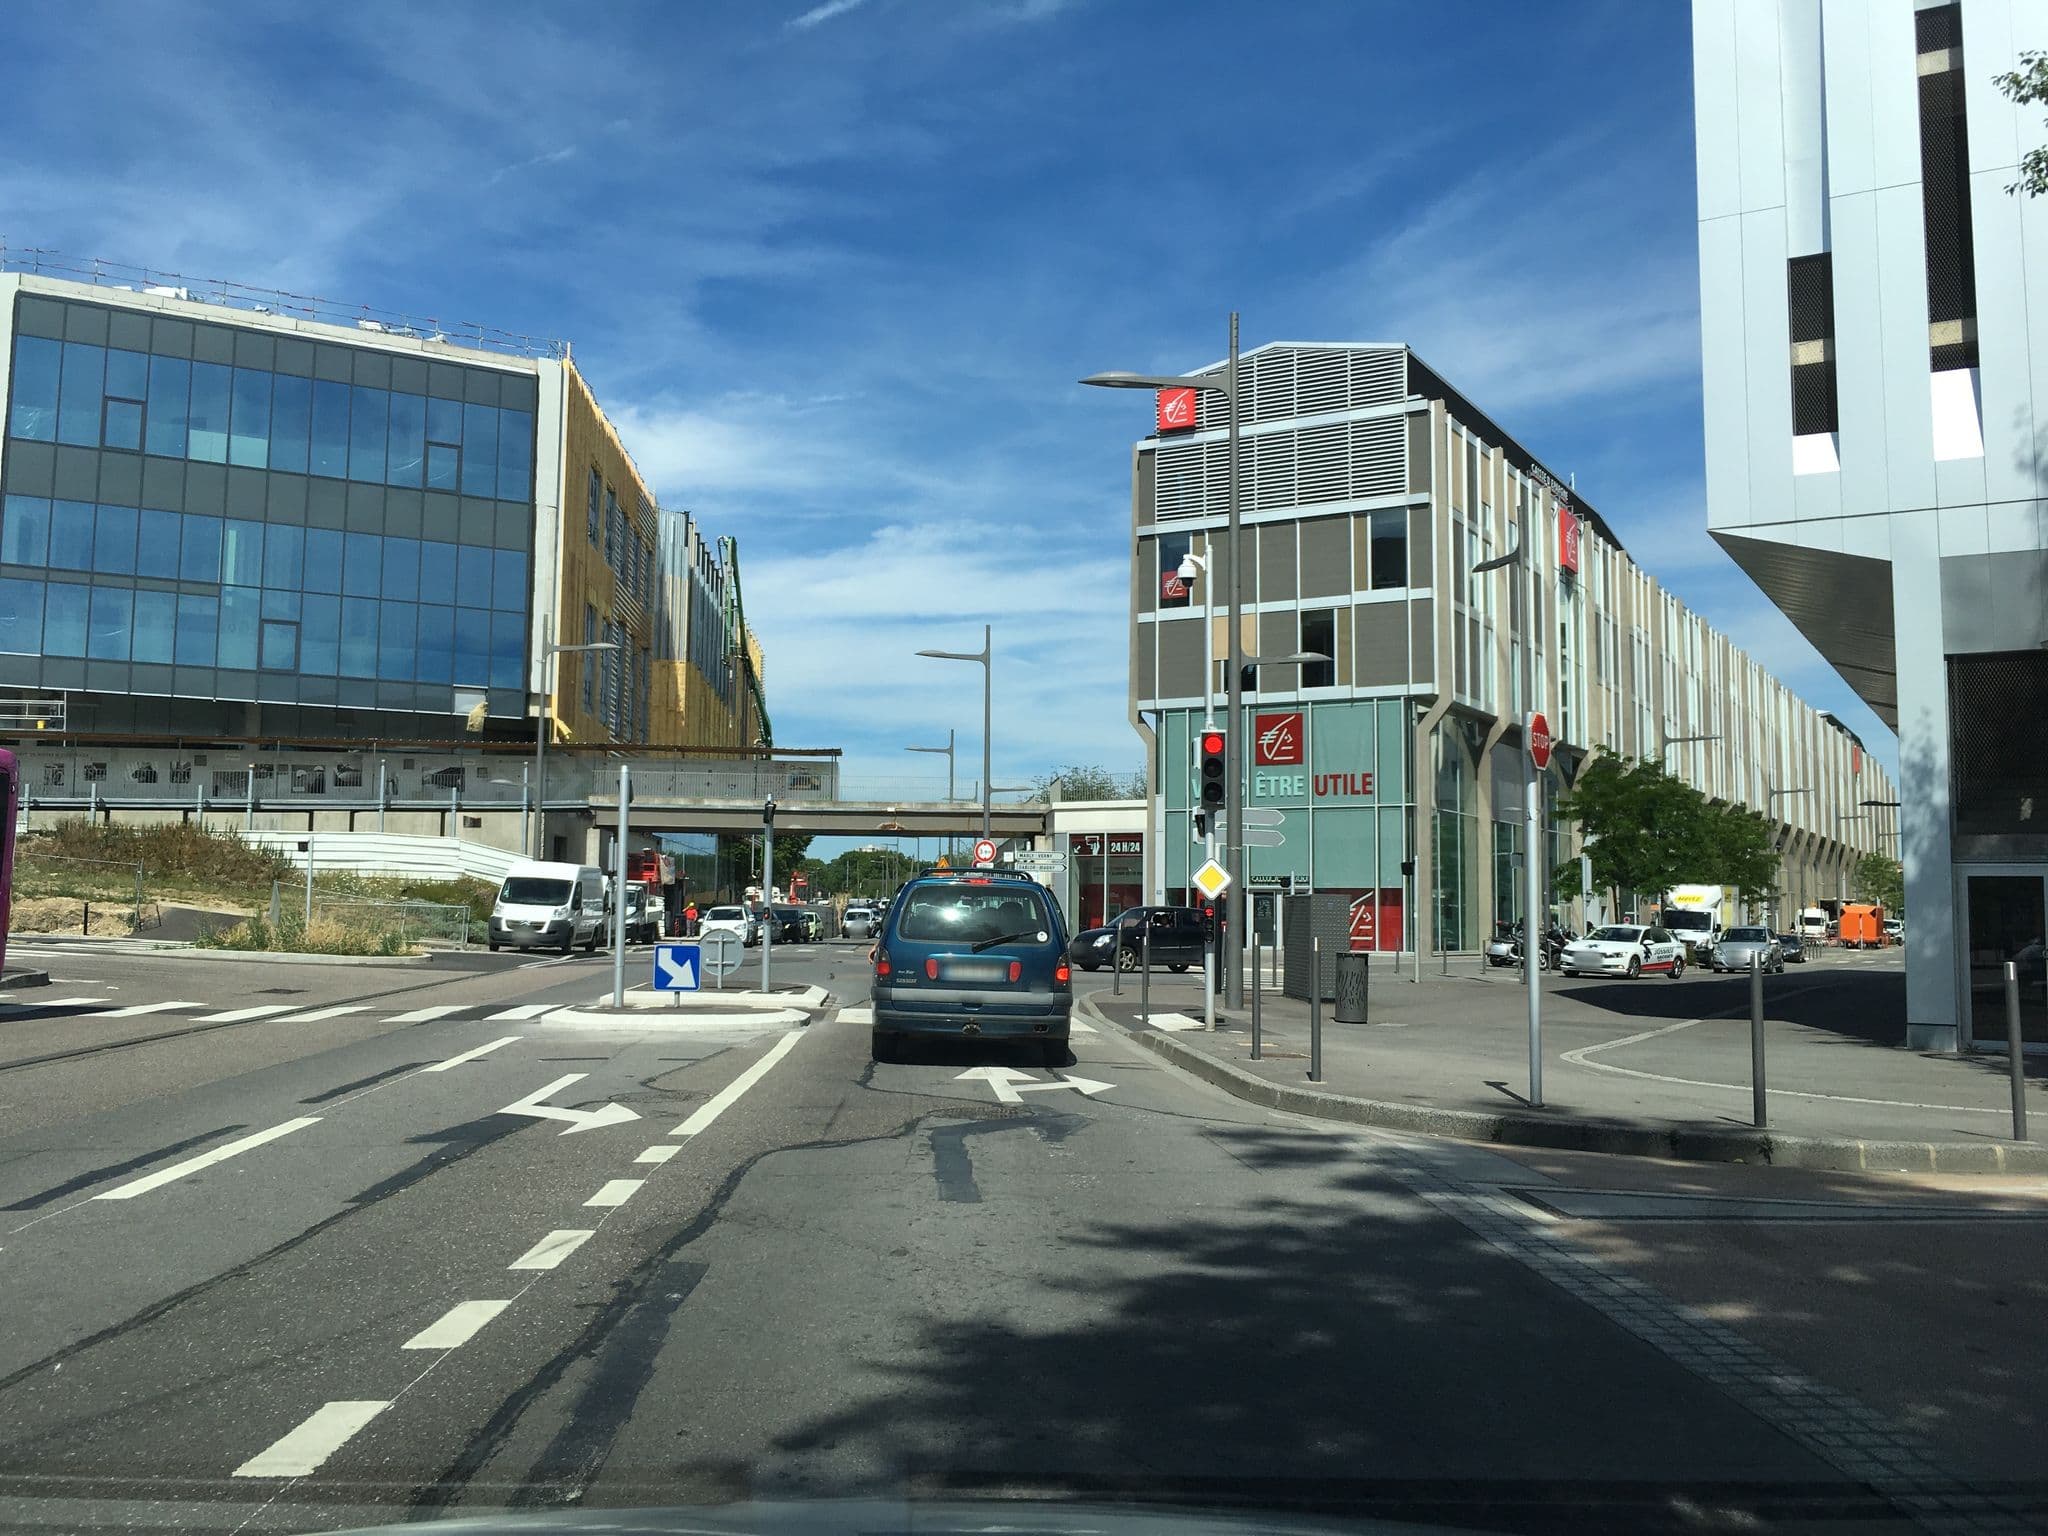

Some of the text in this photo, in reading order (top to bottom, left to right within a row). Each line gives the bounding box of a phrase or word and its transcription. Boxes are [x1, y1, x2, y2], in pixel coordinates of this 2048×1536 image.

[1532, 732, 1549, 750] STOP
[1255, 770, 1305, 798] ÊTRE
[1314, 772, 1373, 797] UTILE
[1111, 841, 1140, 853] 24 H/24
